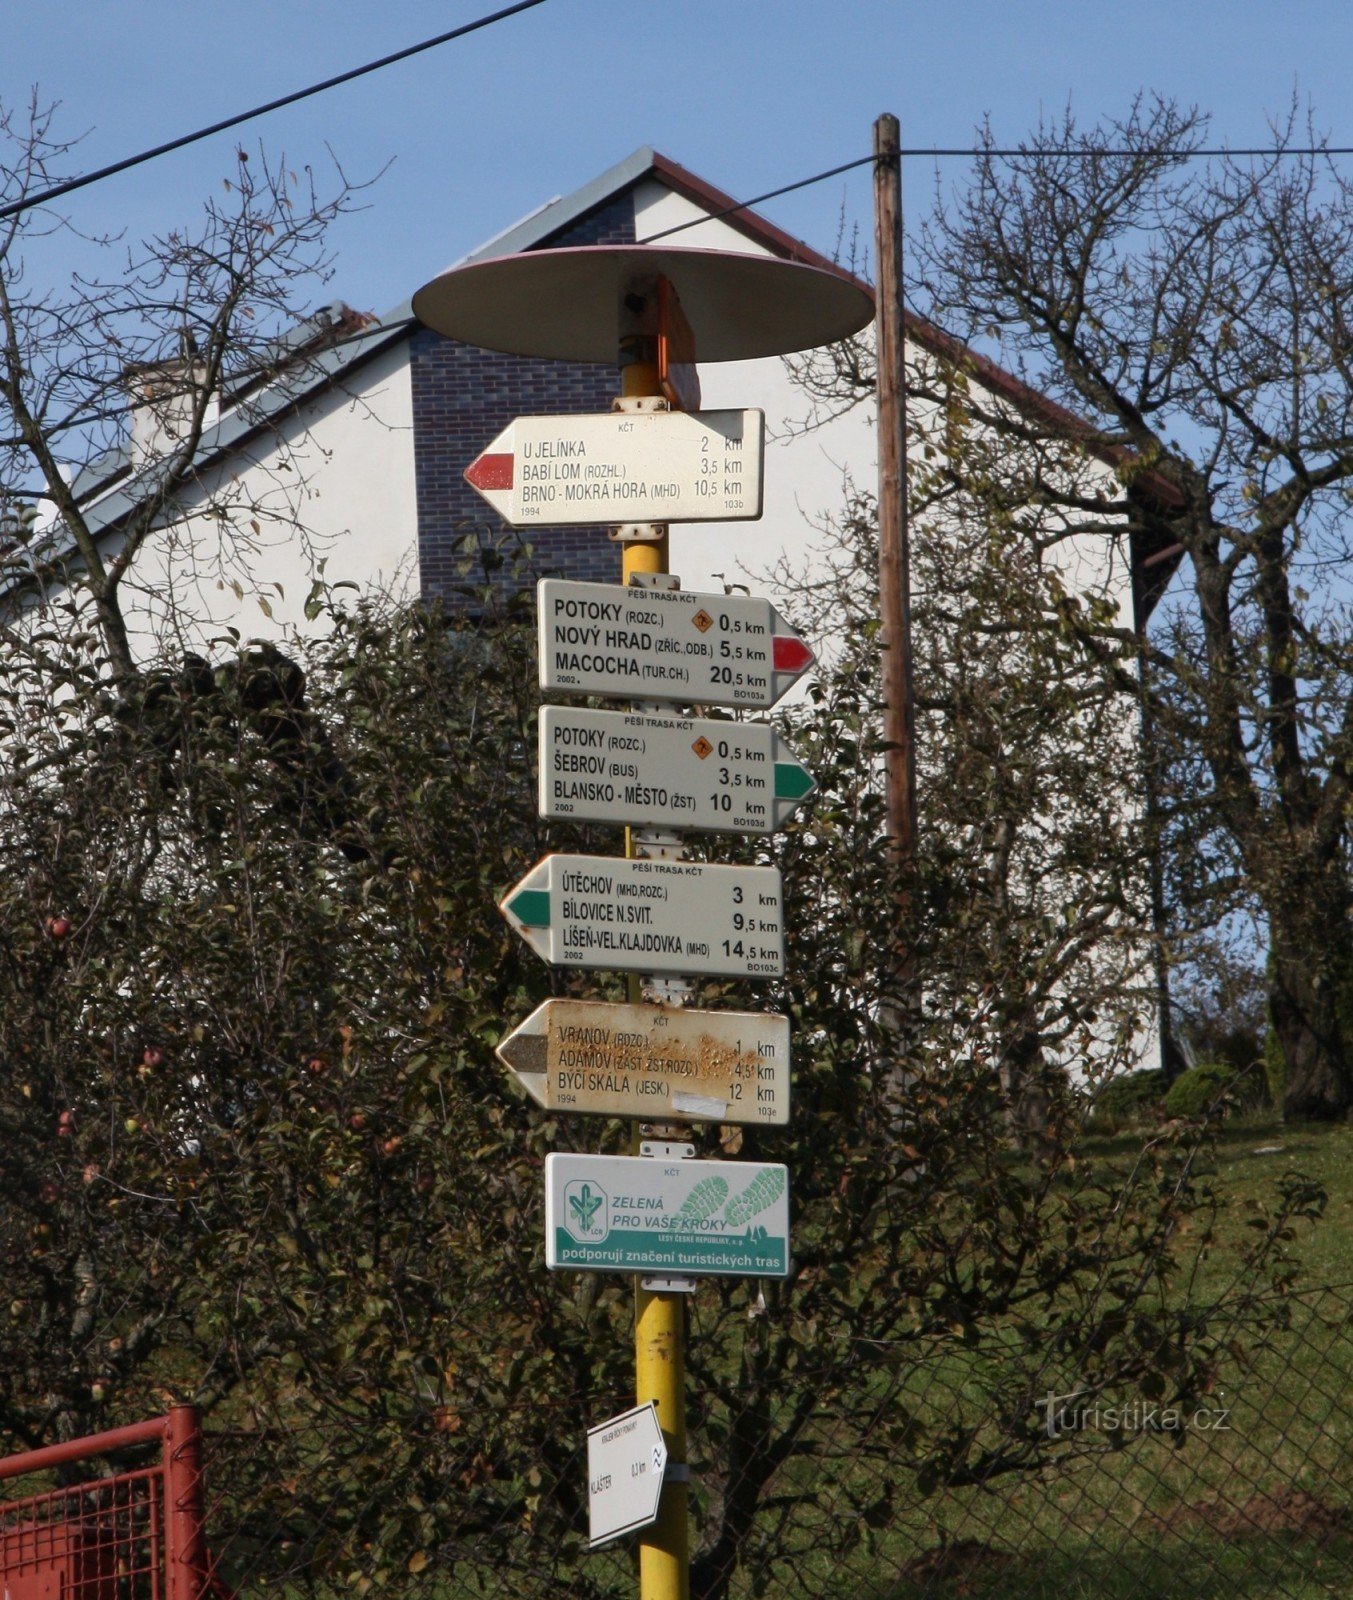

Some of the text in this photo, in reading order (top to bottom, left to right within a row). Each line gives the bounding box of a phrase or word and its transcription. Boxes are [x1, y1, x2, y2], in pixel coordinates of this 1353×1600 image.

[618, 423, 634, 432] KČT
[523, 435, 743, 458] U JELÍNKA 2 km
[522, 458, 742, 480] BABÍ LOM (ROZHL.) 3,5 km
[522, 486, 556, 502] BRNO
[565, 480, 608, 500] MOKRÁ
[613, 483, 647, 498] HORA
[650, 484, 680, 499] (MHD)
[694, 480, 718, 497] 10,5
[724, 480, 742, 495] km
[520, 507, 540, 516] 1994
[724, 500, 744, 509] 103b
[650, 592, 677, 602] TRASA
[554, 599, 765, 634] POTOKY (ROZC.) 0,5 km
[554, 624, 601, 646] NOVÝ
[605, 630, 652, 651] HRAD
[720, 641, 743, 661] 5,5
[746, 648, 766, 661] km
[555, 652, 766, 687] MACOCHA (TUR.CH.) 20,5 km
[646, 718, 675, 729] TRASA
[676, 720, 694, 730] KČT
[554, 726, 765, 761] POTOKY (ROZC.) 0,5 km
[554, 749, 765, 788] ŠEBROV (BUS) 3,5 km
[554, 780, 614, 802] BLANSKO
[624, 783, 668, 806] MĚSTO
[670, 793, 696, 811] (ŽST)
[710, 793, 732, 812] 10
[745, 801, 765, 814] km
[555, 803, 574, 812] 2002
[654, 864, 684, 875] TRASA
[685, 865, 703, 876] KČT
[562, 869, 777, 906] ÚTĚCHOV (MHD,ROZC.) 3 km
[562, 897, 614, 921] BÍLOVICE
[733, 913, 756, 932] 9,5
[760, 919, 778, 932] km
[564, 951, 583, 960] 2002
[686, 941, 710, 957] (MHD)
[722, 940, 756, 959] 14,5
[760, 946, 779, 959] km
[653, 1016, 669, 1026] KČT
[559, 1027, 610, 1045] VRANOV
[736, 1040, 741, 1054] 1
[757, 1041, 775, 1057] km
[558, 1050, 611, 1067] ADAMOV
[757, 1064, 775, 1080] km
[559, 1068, 775, 1102] BÝČÍ SKÁLA (JESK.) 12 km
[557, 1094, 576, 1104] 1994
[664, 1168, 680, 1177] KČT
[612, 1195, 664, 1210] ZELENÁ
[612, 1215, 728, 1231] PRO VAŠE KROKY
[562, 1248, 781, 1268] podporují značení turistických tras
